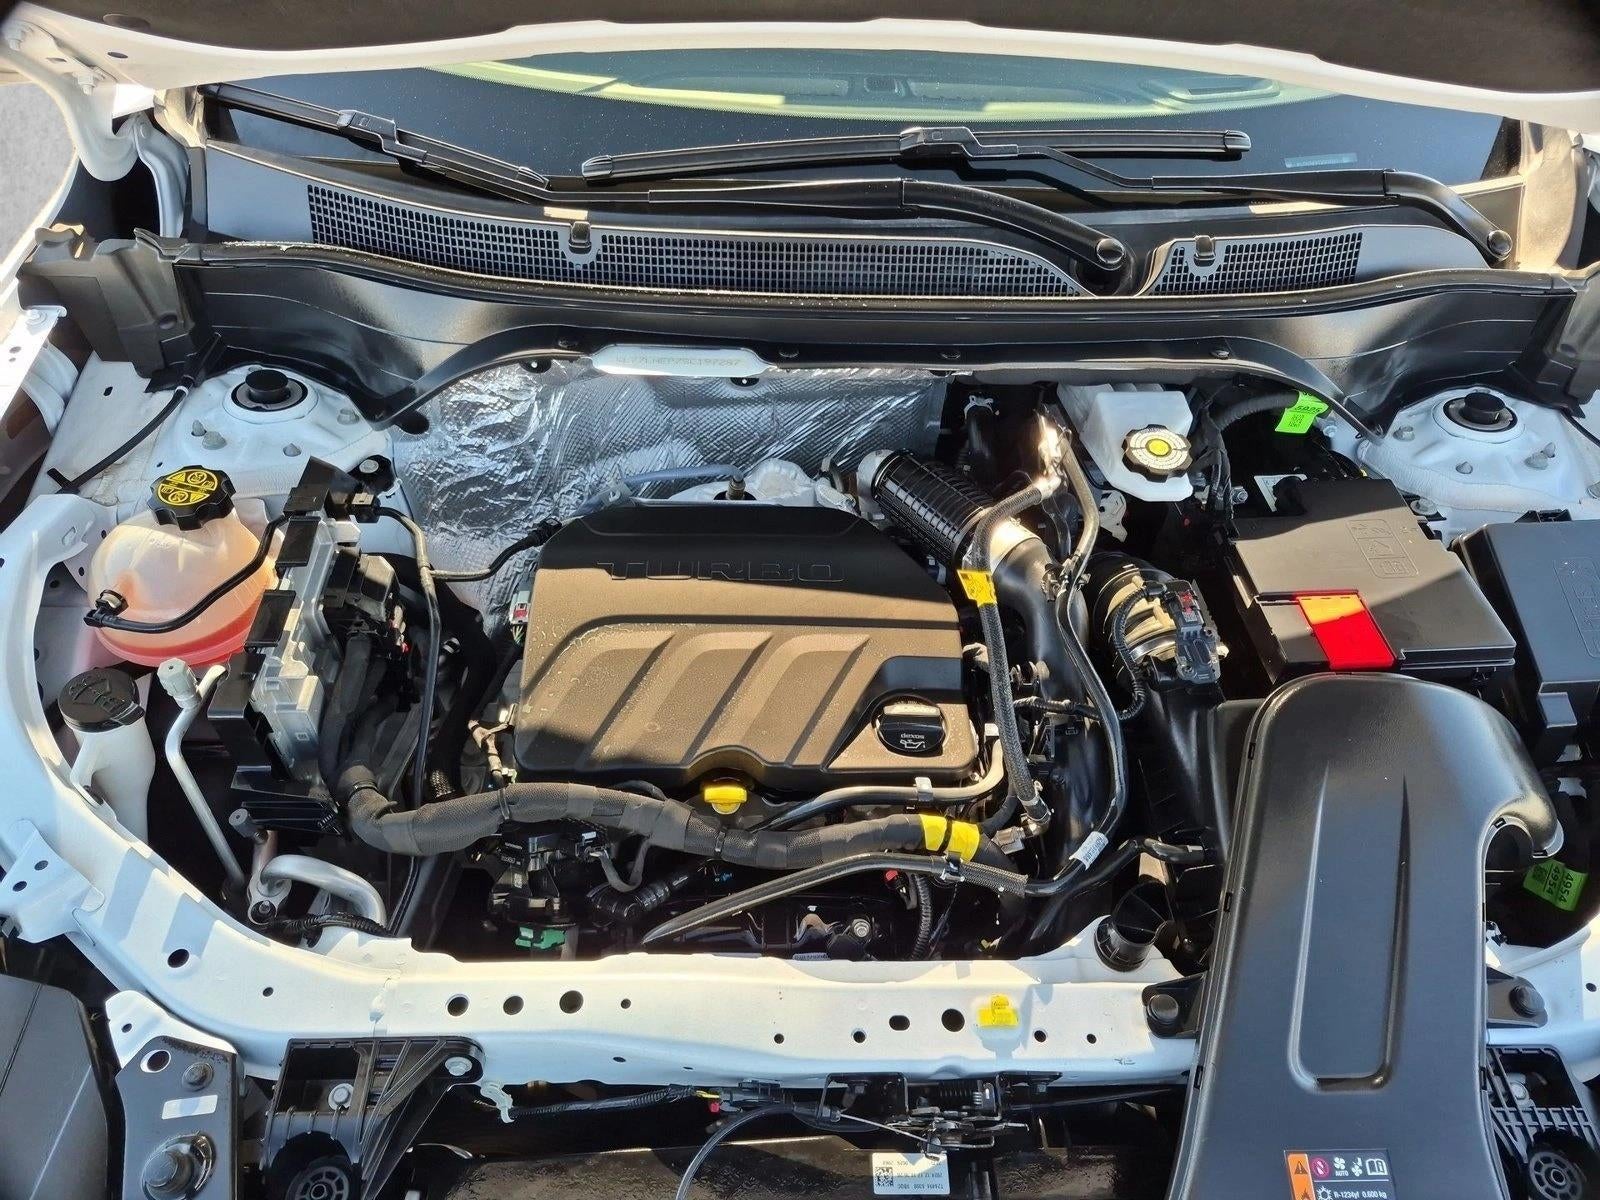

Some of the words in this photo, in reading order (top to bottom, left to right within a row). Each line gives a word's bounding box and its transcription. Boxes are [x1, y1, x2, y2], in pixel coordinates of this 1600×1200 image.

[597, 560, 845, 581] TURBO
[900, 732, 925, 740] dexos
[1546, 866, 1560, 895] 4954
[1559, 872, 1574, 903] 4954
[1335, 1169, 1349, 1177] AUTO
